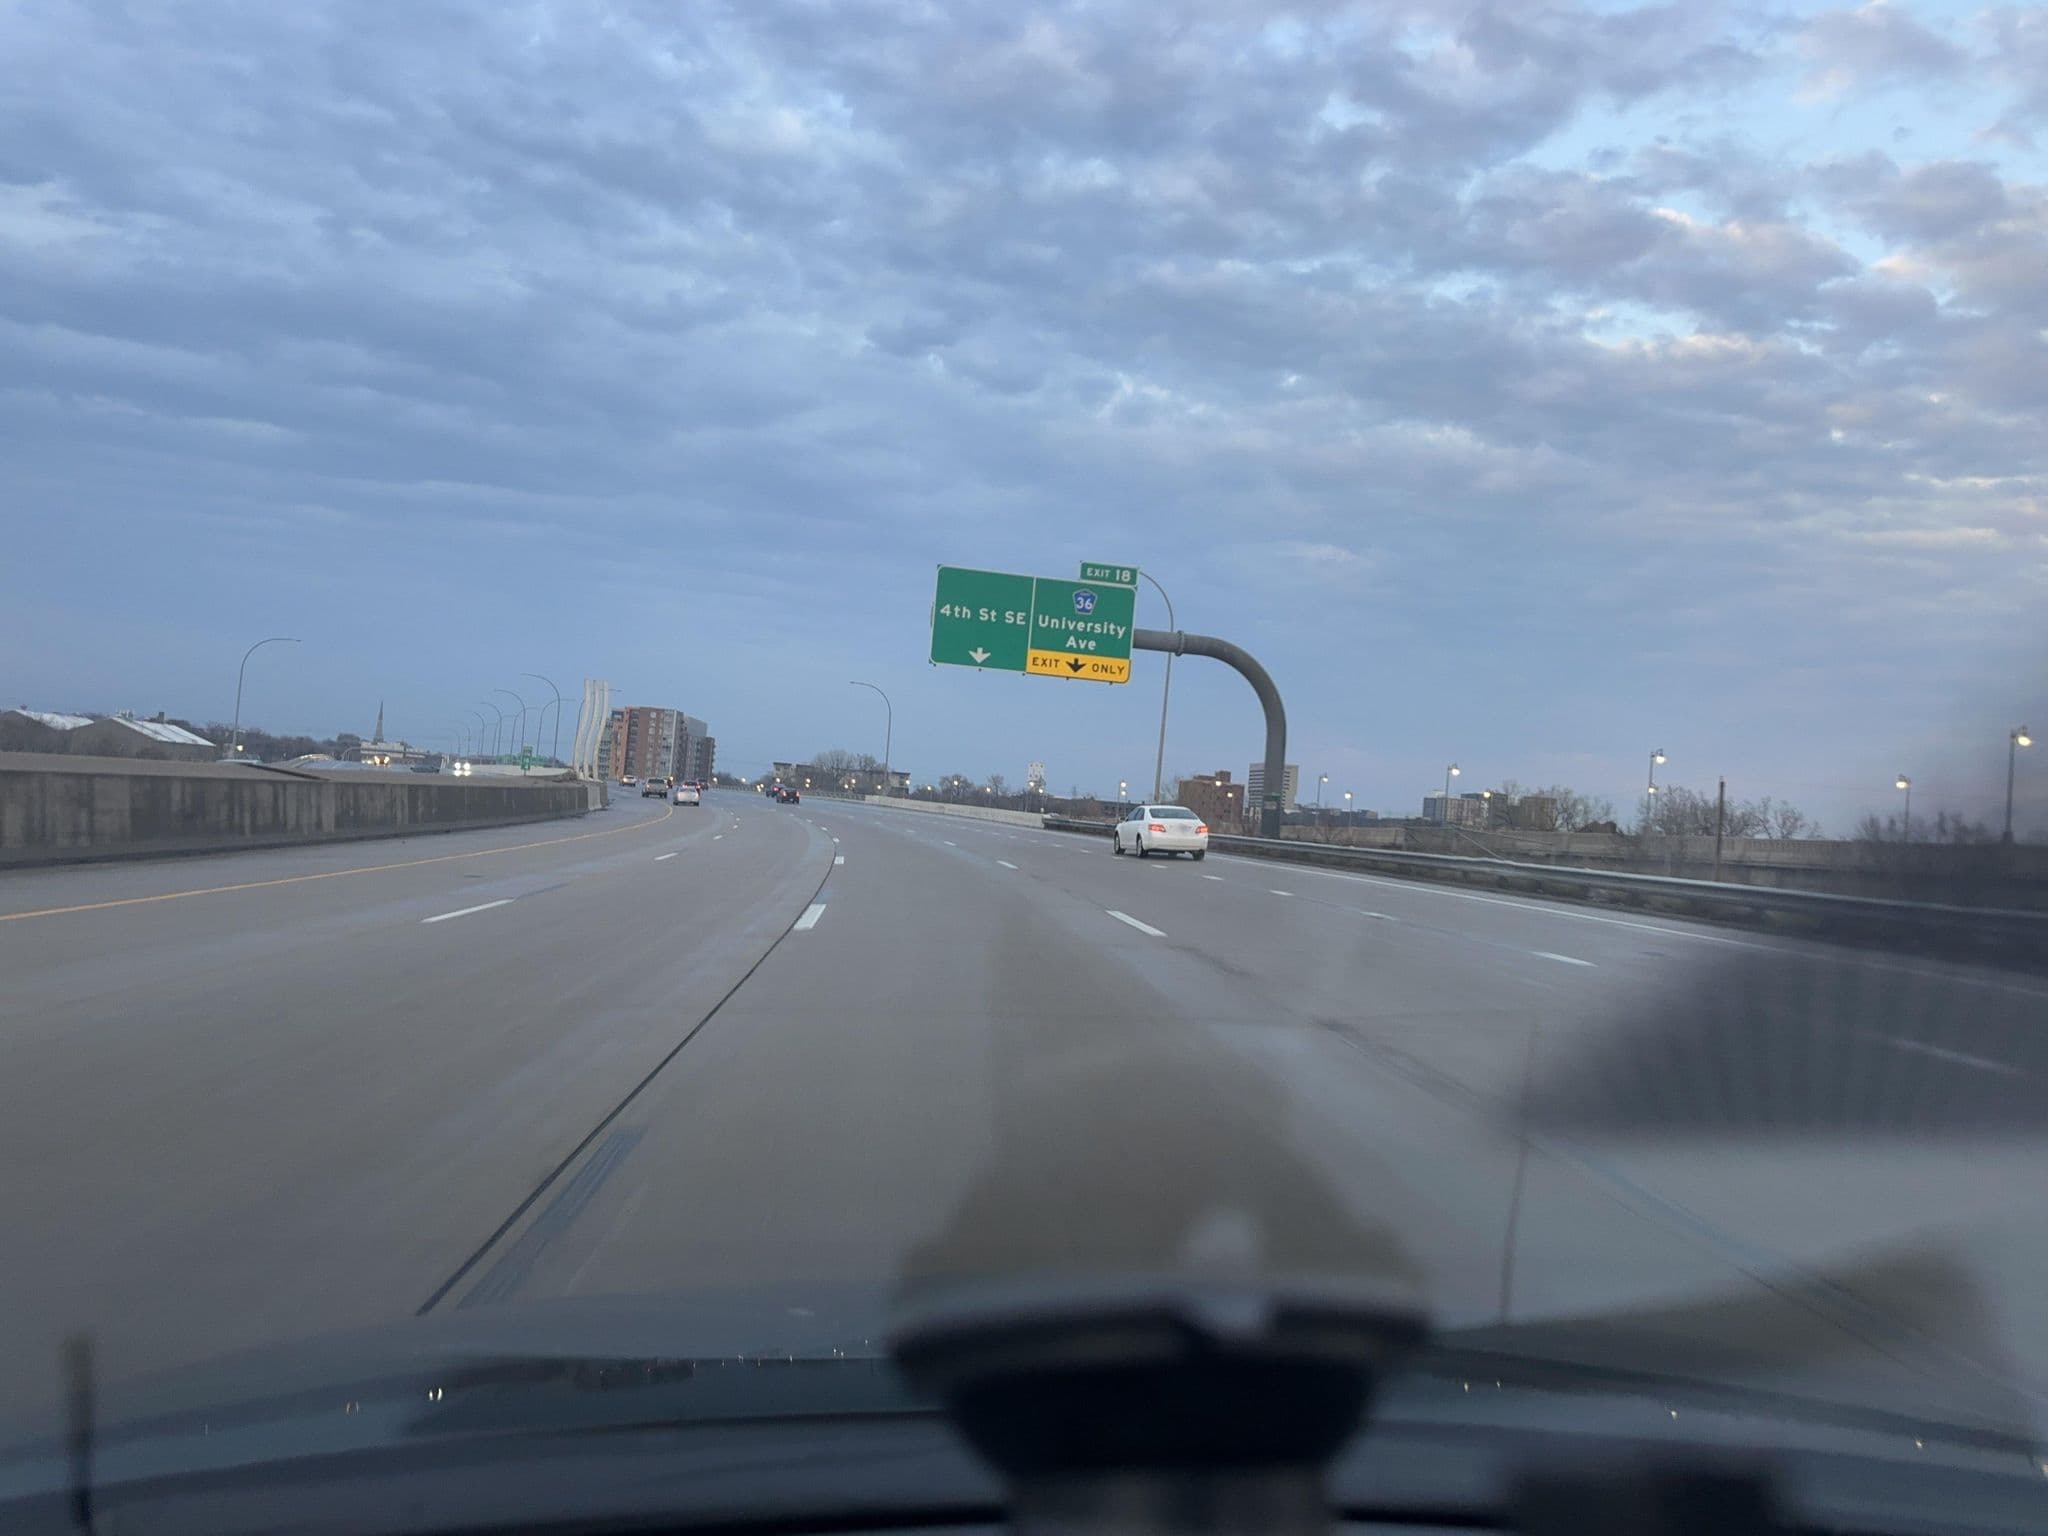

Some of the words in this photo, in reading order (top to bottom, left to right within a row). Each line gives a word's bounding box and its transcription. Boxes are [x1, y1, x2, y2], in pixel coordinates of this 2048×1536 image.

[1086, 567, 1111, 578] EXIT
[1115, 569, 1132, 582] 18
[1076, 597, 1094, 610] 36
[940, 603, 971, 619] 4th
[979, 608, 997, 623] St
[1005, 611, 1026, 625] SE
[1038, 614, 1126, 638] University
[1065, 636, 1097, 650] Ave
[1032, 656, 1060, 668] EXIT
[1091, 663, 1125, 675] ONLY
